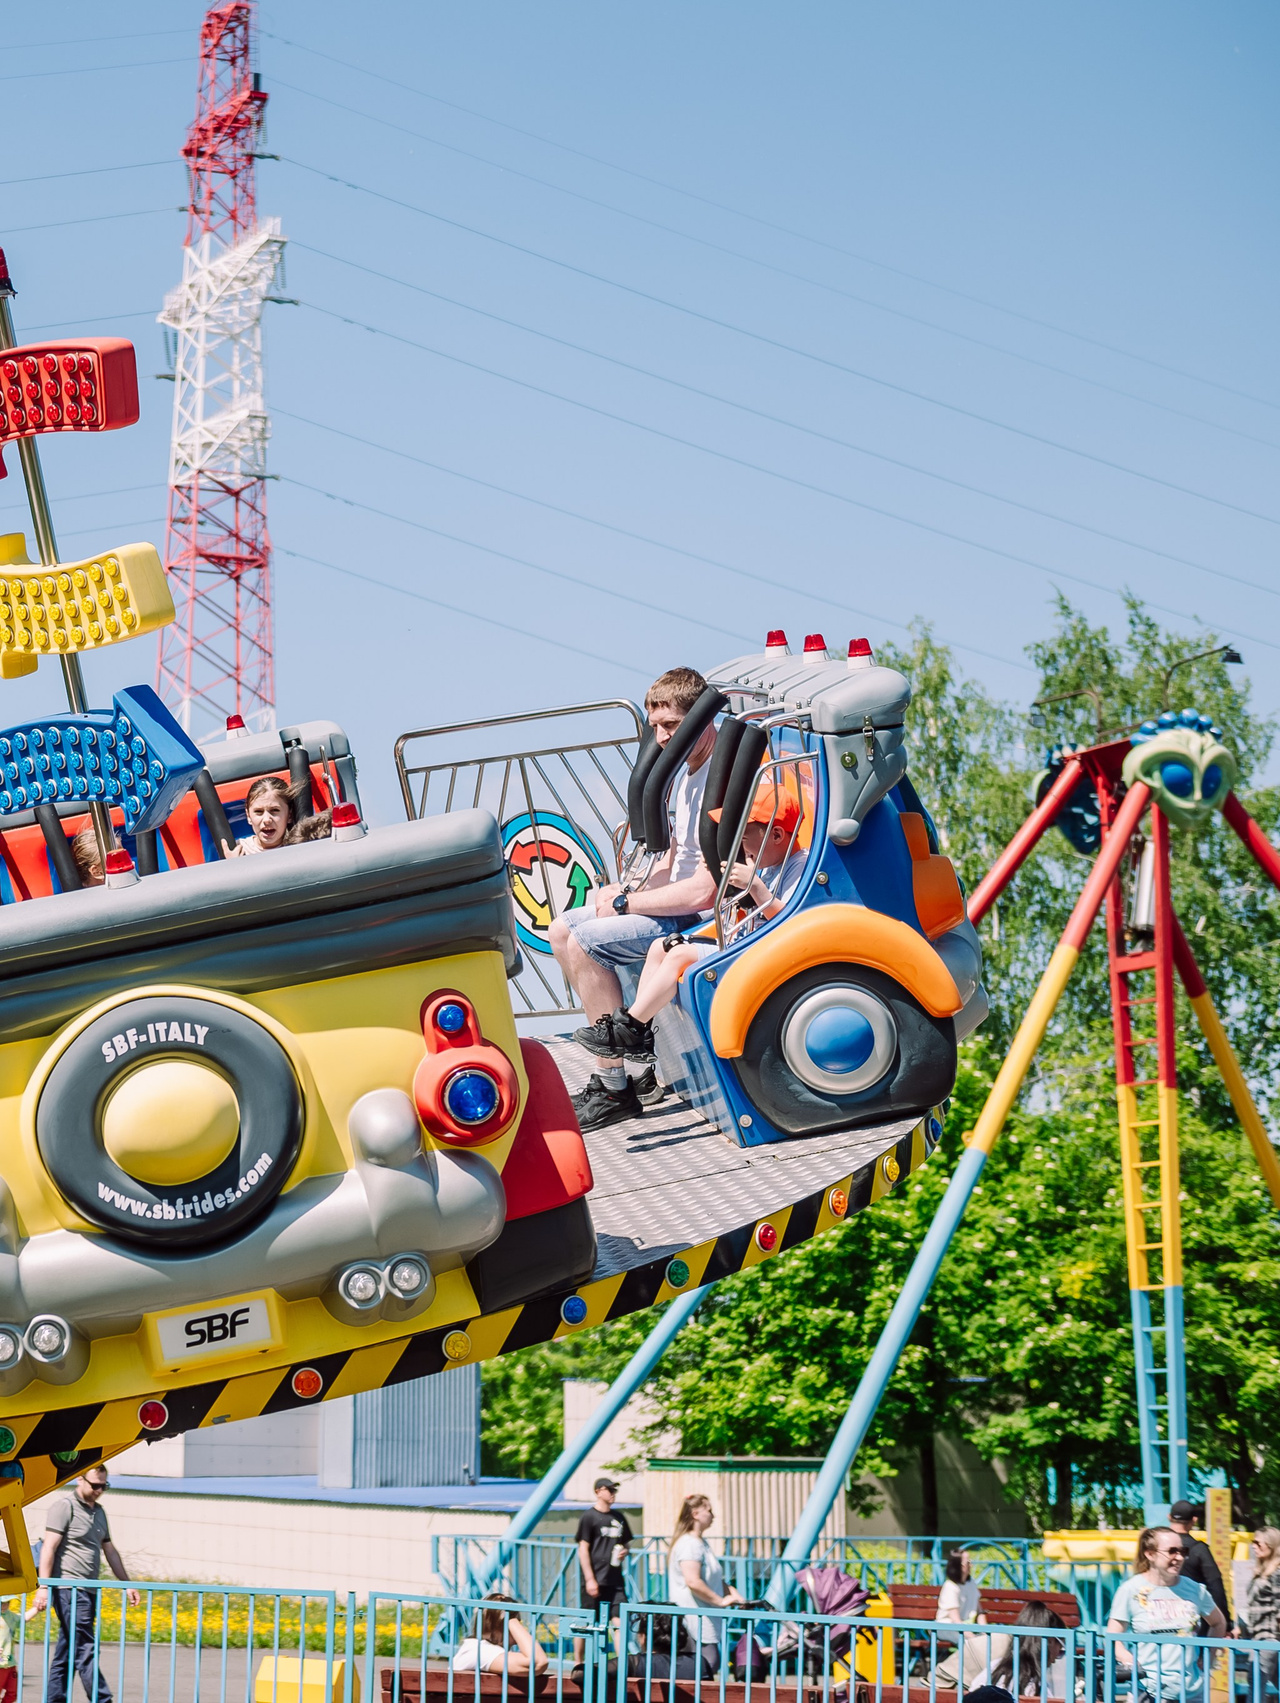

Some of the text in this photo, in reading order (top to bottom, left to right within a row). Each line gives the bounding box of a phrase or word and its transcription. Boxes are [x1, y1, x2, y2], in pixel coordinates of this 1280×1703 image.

[101, 1021, 209, 1063] SBF-ITALY
[98, 1152, 273, 1221] www.sbfrides.com
[184, 1307, 250, 1348] SBF
